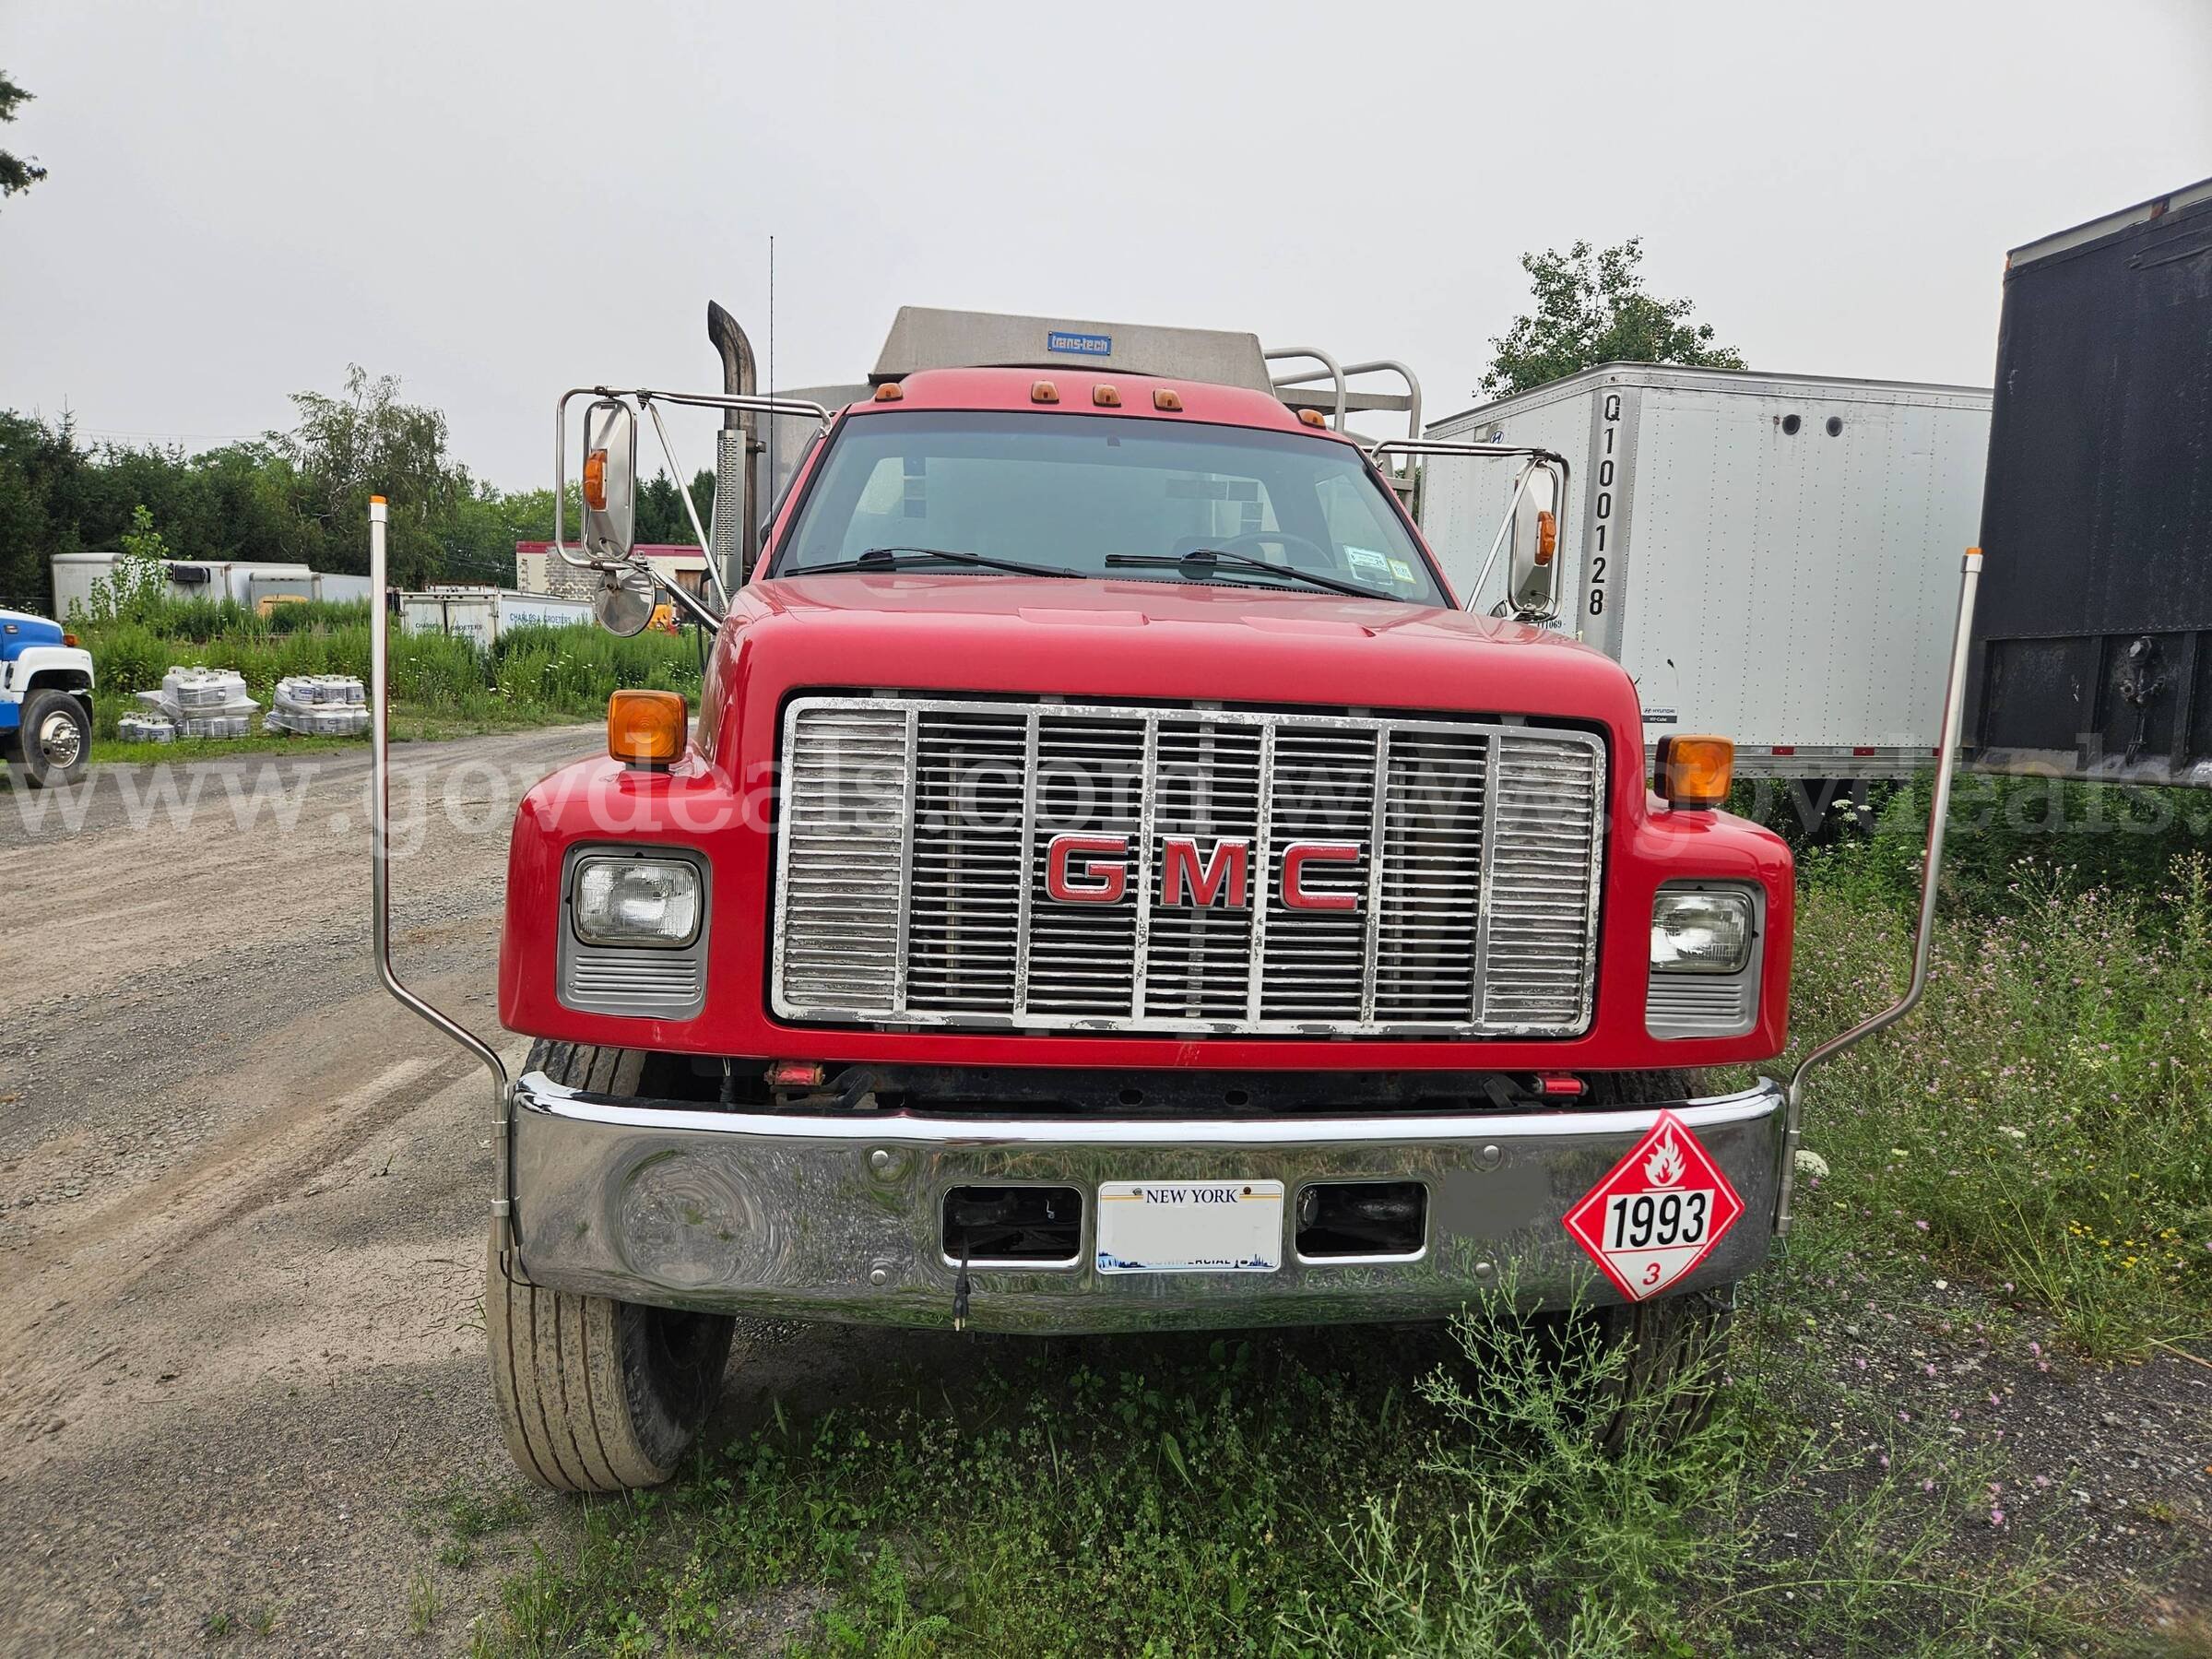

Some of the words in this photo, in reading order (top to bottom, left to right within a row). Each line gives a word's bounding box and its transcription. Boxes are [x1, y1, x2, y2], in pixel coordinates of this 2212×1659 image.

[1051, 335, 1108, 352] trans-tech
[1589, 394, 1621, 616] Q100128
[1046, 834, 1361, 912] GMC
[1146, 1189, 1187, 1203] NEW
[1190, 1189, 1238, 1203] YORK
[1613, 1192, 1706, 1248] 1993
[1642, 1262, 1662, 1286] 3
